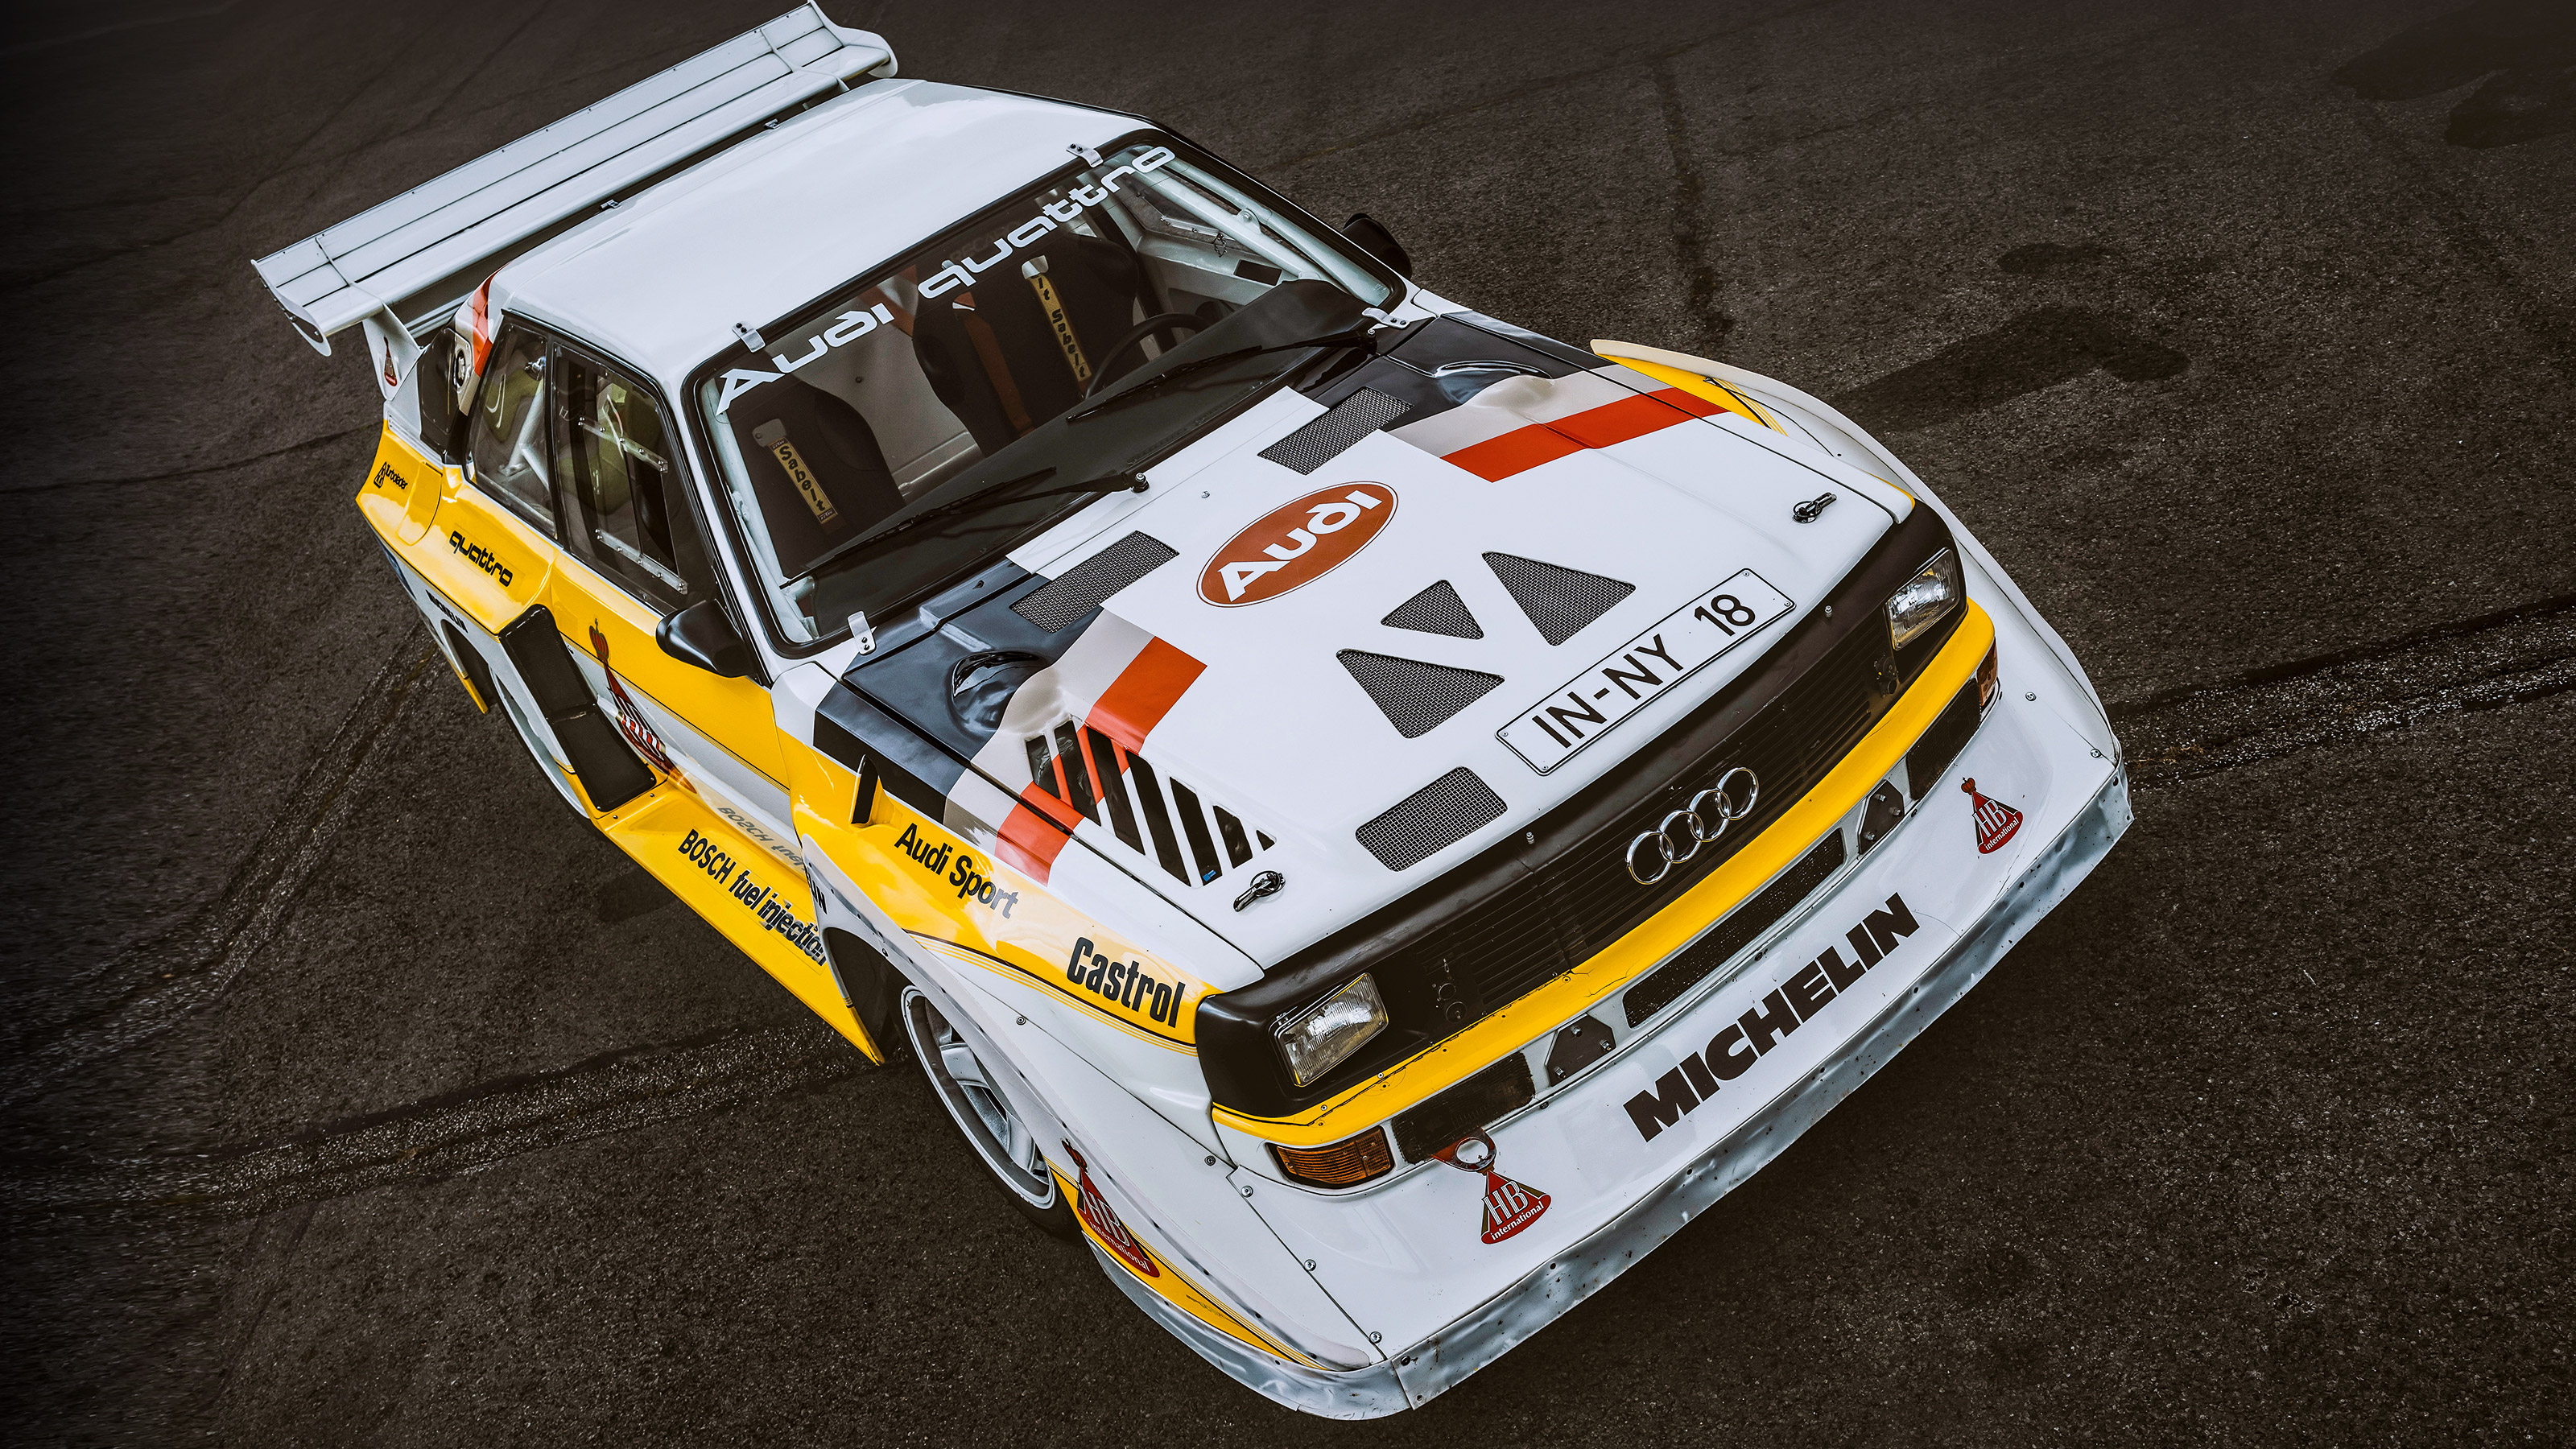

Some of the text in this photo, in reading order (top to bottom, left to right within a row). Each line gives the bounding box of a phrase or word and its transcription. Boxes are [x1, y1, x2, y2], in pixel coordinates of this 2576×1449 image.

[716, 146, 1176, 416] Audi quattro
[1051, 308, 1085, 378] Sabelt
[778, 445, 826, 511] Sabelt
[449, 530, 513, 587] quattro
[1217, 489, 1383, 602] Audi
[1531, 594, 1756, 749] IN-NY 18
[1972, 799, 2008, 838] HB
[1984, 816, 2019, 851] international
[678, 828, 828, 966] BOSCH fuel injection
[894, 823, 1018, 919] Audi Sport
[1067, 936, 1186, 1028] Castrol
[1623, 891, 1921, 1143] MICHELIN
[1079, 1183, 1130, 1248] HB
[1482, 1181, 1529, 1227] HB
[1490, 1201, 1545, 1241] international
[1088, 1217, 1150, 1272] international
